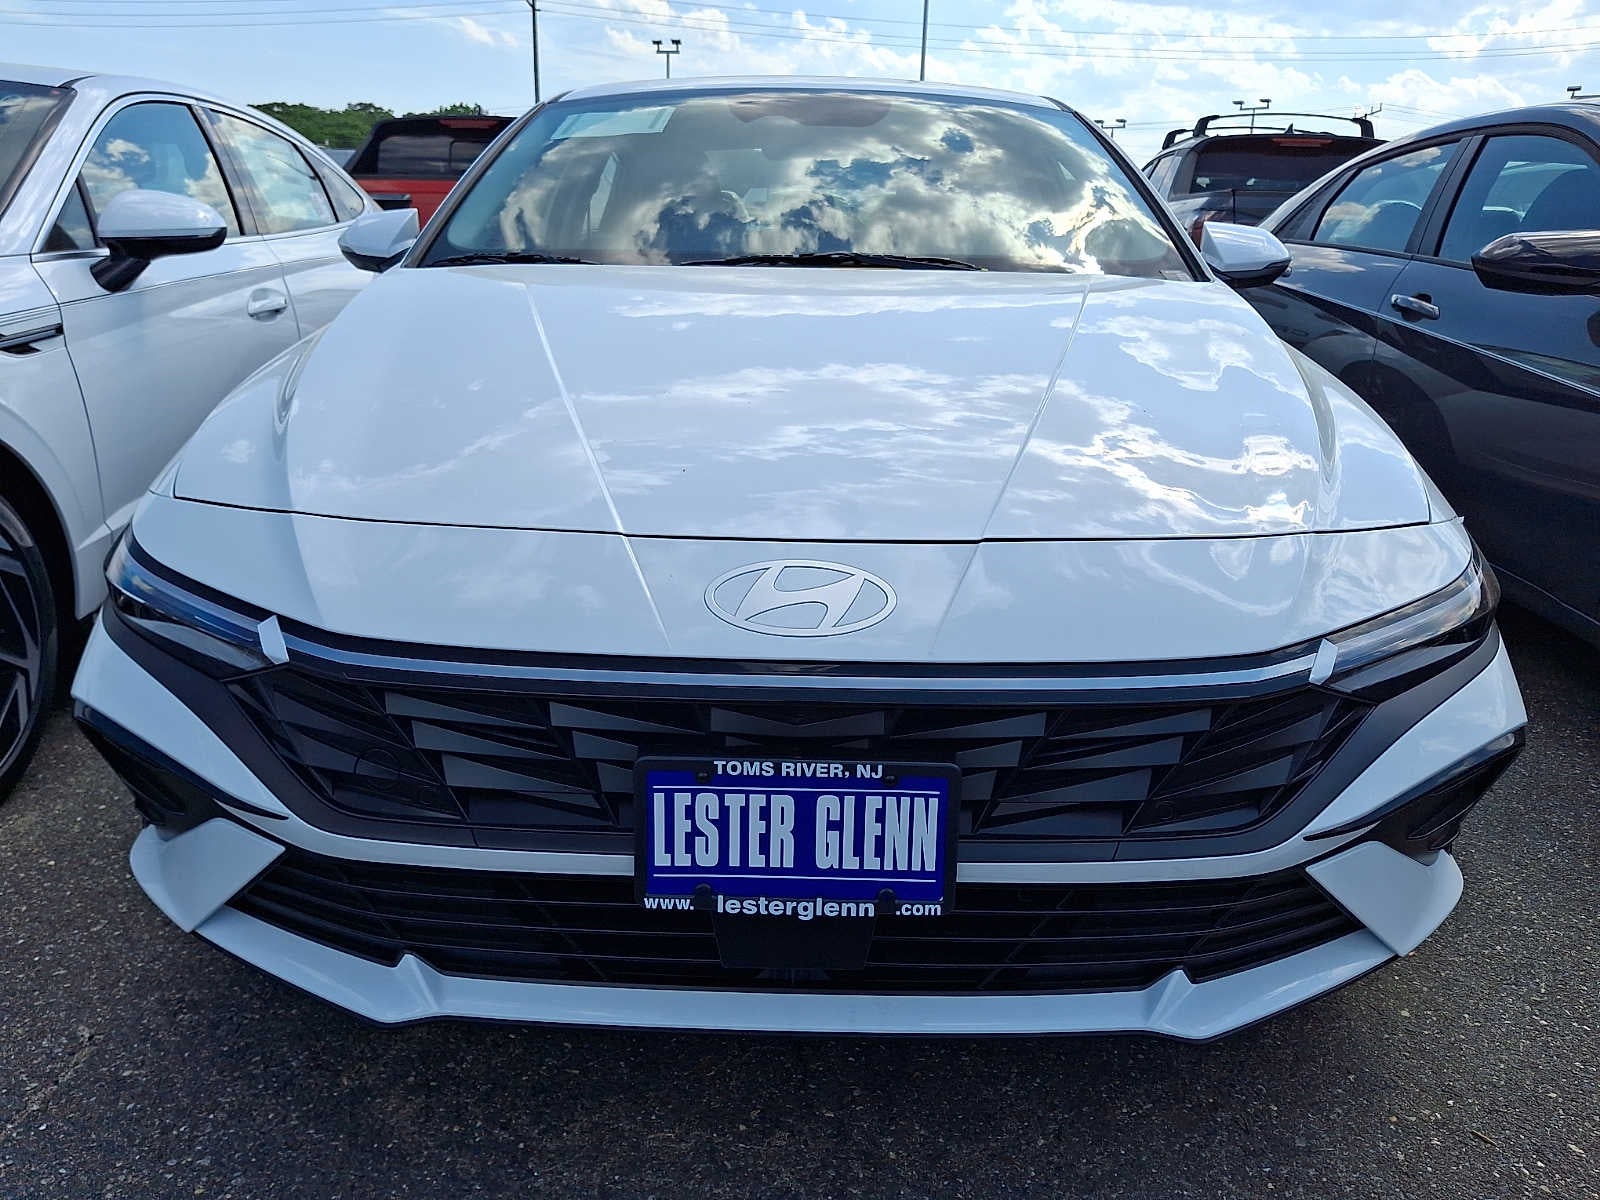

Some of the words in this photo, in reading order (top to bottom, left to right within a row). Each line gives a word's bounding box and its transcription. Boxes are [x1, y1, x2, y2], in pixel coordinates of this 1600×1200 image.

[713, 760, 774, 776] TOMS
[781, 761, 849, 778] RIVER,
[856, 764, 883, 780] NJ
[653, 792, 795, 868] LESTER
[815, 794, 939, 872] GLENN
[644, 897, 695, 912] www.
[717, 895, 874, 921] lesterglenn
[895, 901, 942, 917] .com
